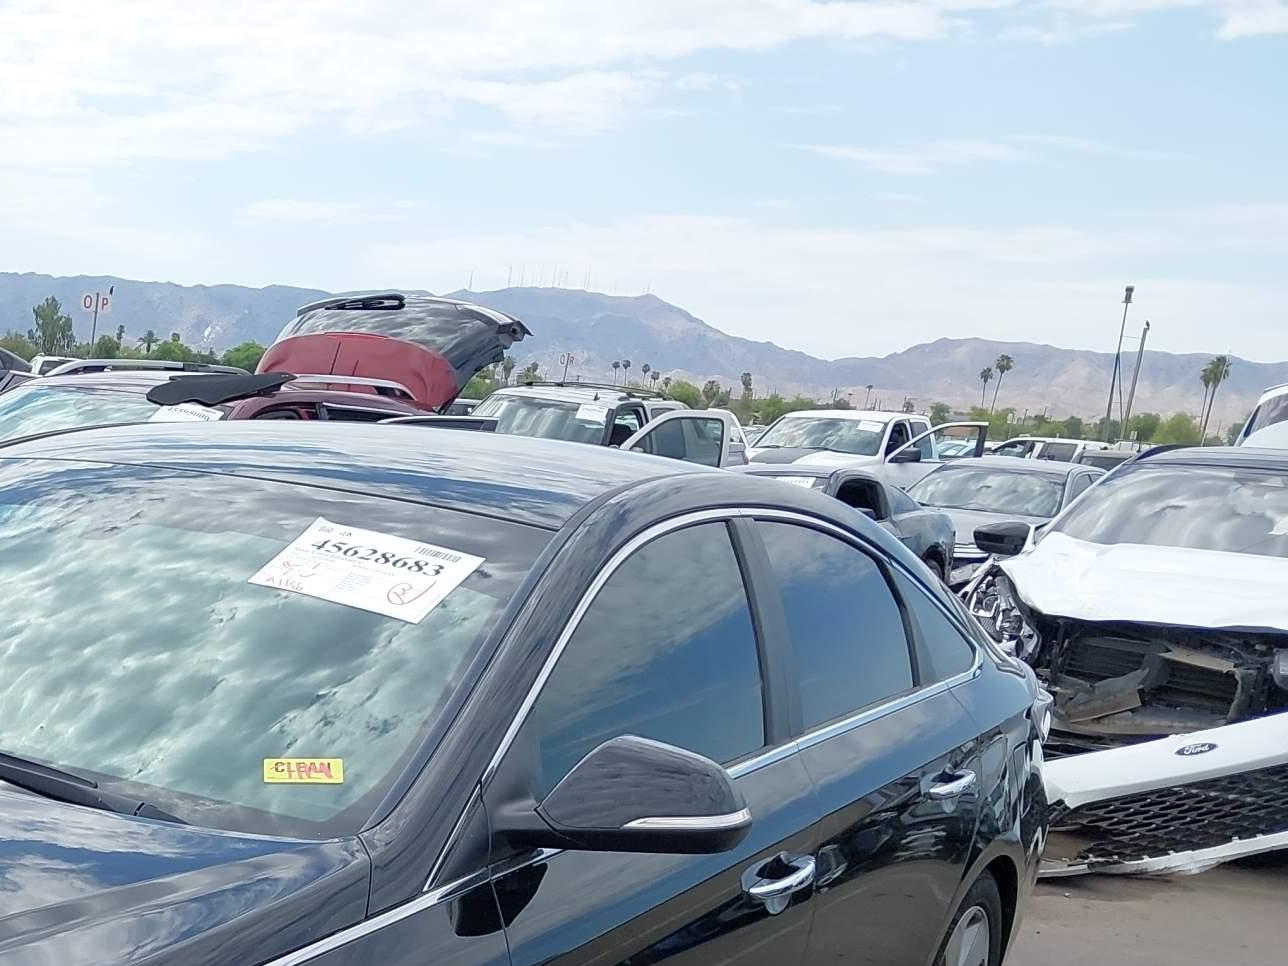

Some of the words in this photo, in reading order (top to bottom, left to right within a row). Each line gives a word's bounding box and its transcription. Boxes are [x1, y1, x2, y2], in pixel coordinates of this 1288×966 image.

[101, 297, 109, 311] P
[311, 539, 445, 577] 45628683
[1184, 744, 1210, 754] Ford
[273, 761, 332, 777] CLEAN
